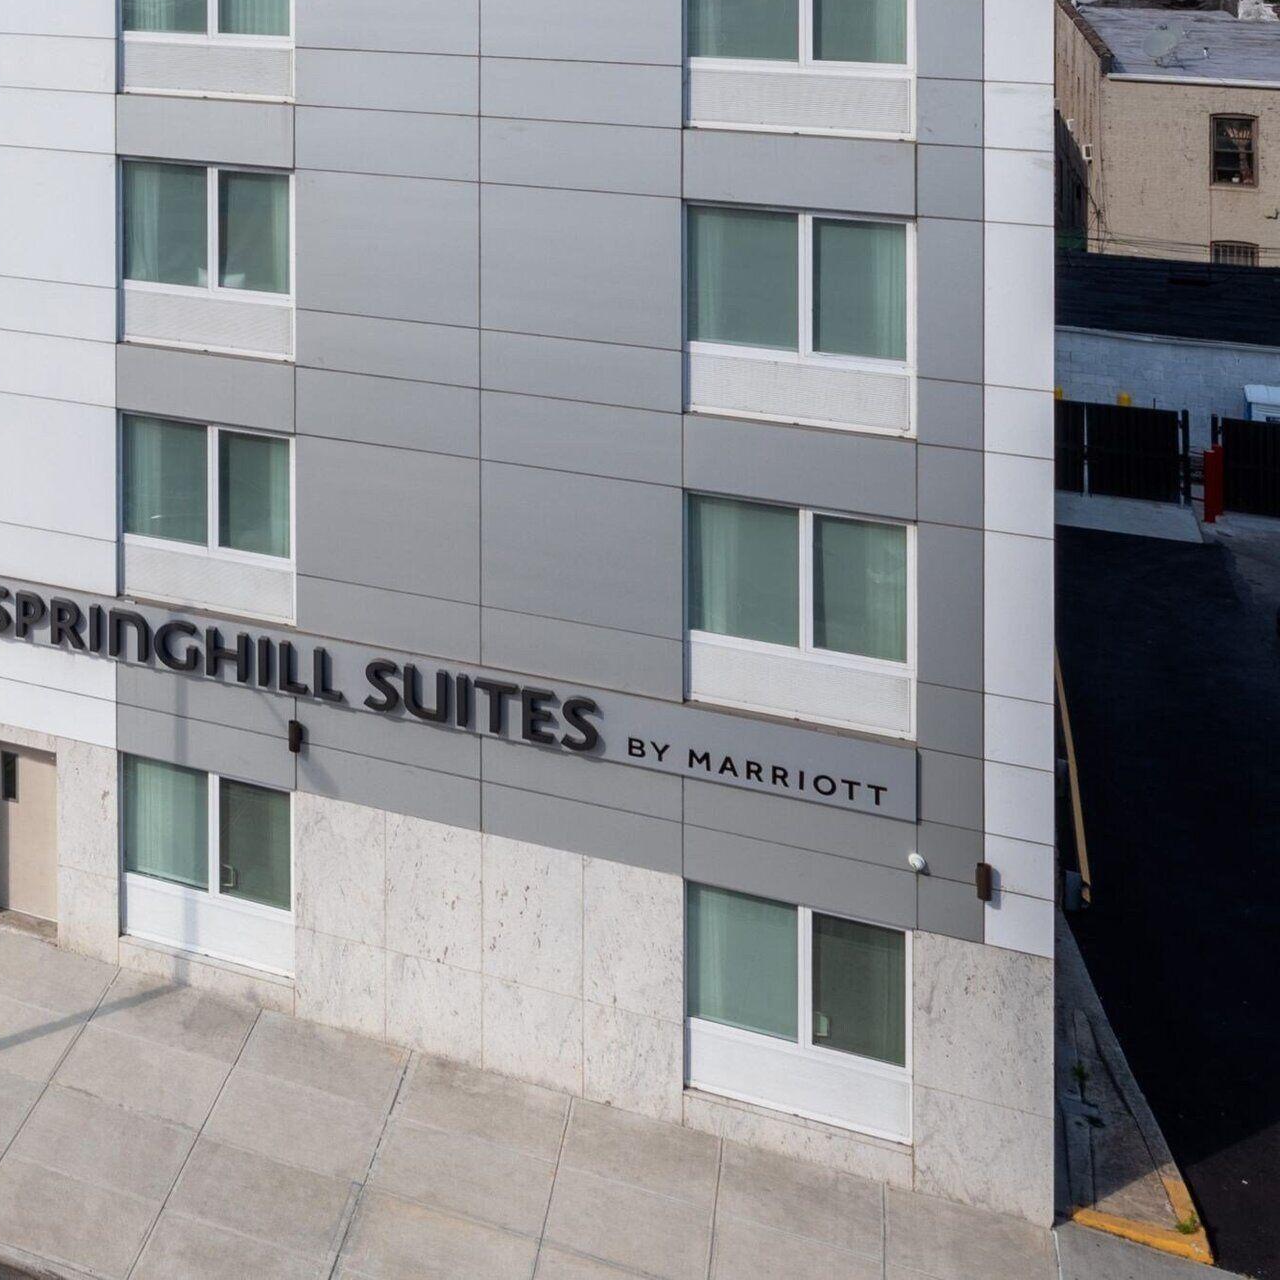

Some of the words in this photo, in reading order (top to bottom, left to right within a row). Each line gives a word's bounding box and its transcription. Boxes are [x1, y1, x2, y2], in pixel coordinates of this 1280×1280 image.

[363, 657, 601, 752] SUITES
[627, 737, 671, 761] BY
[688, 748, 889, 807] MARRIOTT
